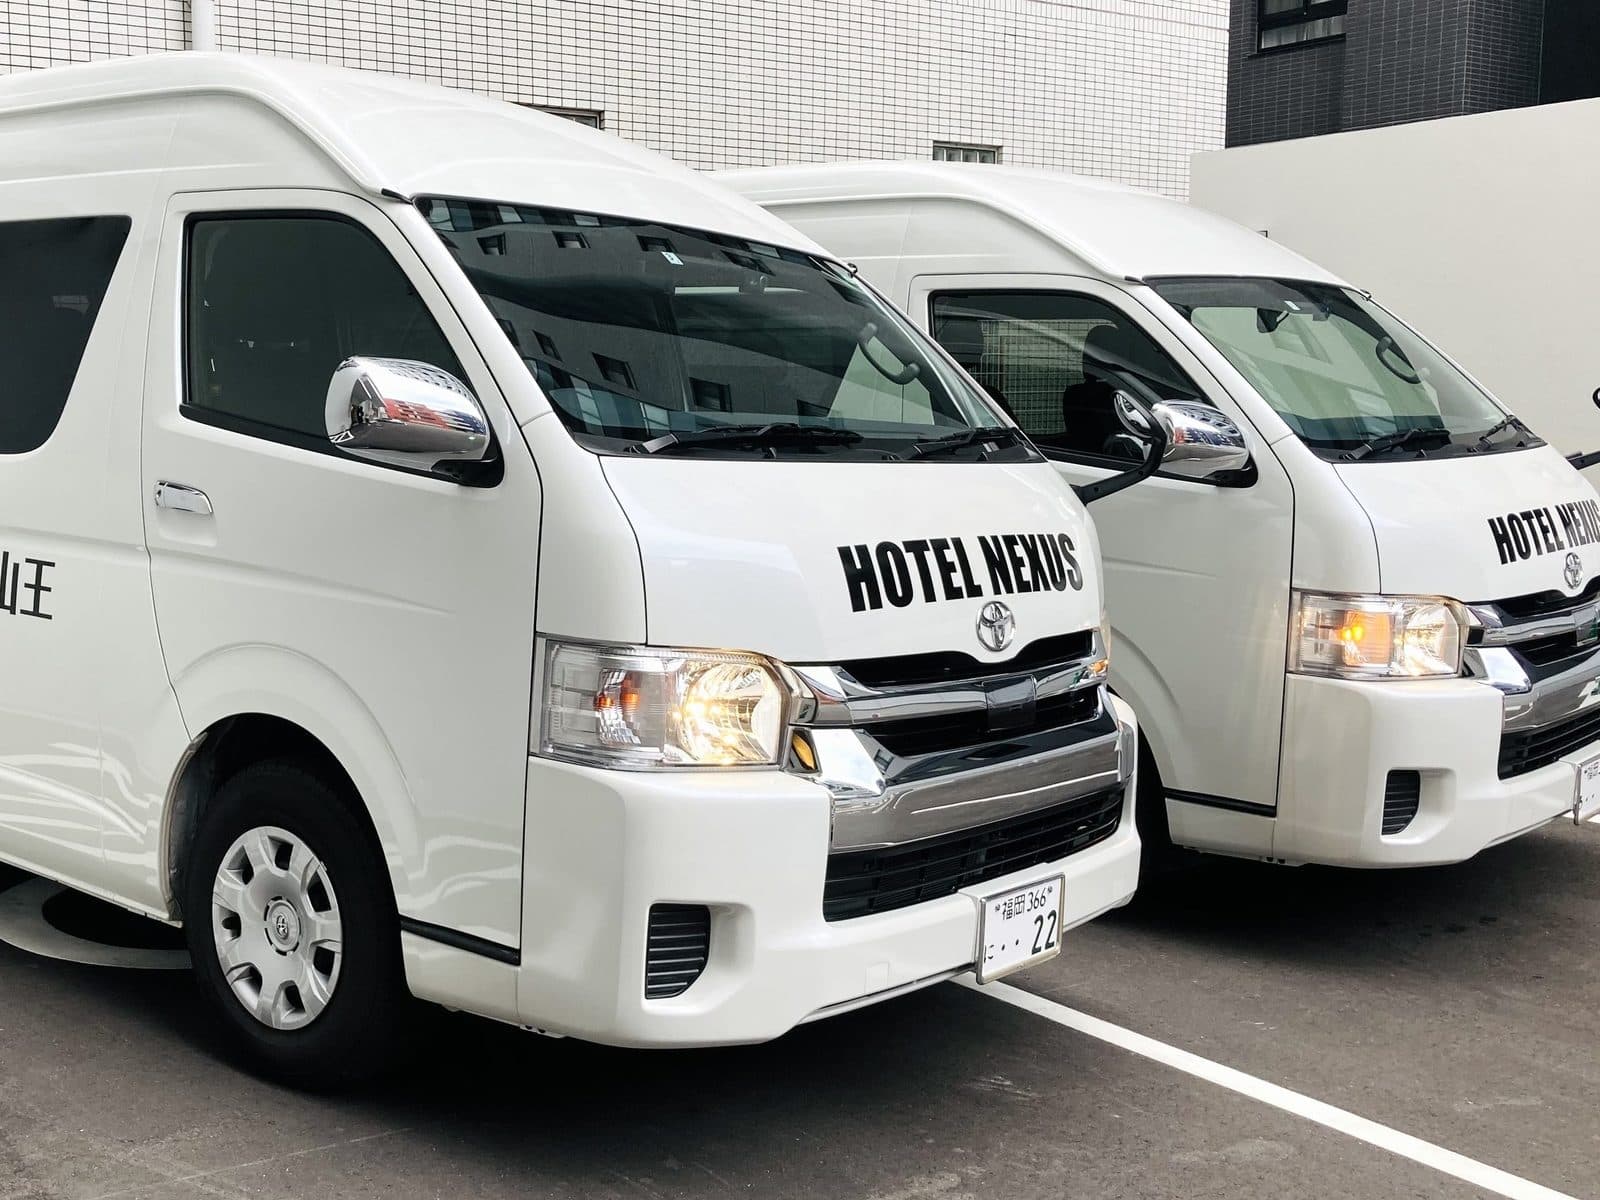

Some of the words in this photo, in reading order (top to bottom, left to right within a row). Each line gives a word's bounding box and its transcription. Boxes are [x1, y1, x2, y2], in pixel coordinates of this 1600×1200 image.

[1487, 507, 1565, 565] HOTEL
[837, 537, 984, 613] HOTEL
[977, 532, 1084, 596] NEXUS
[1002, 893, 1026, 920] 福岡
[1026, 887, 1047, 913] 366
